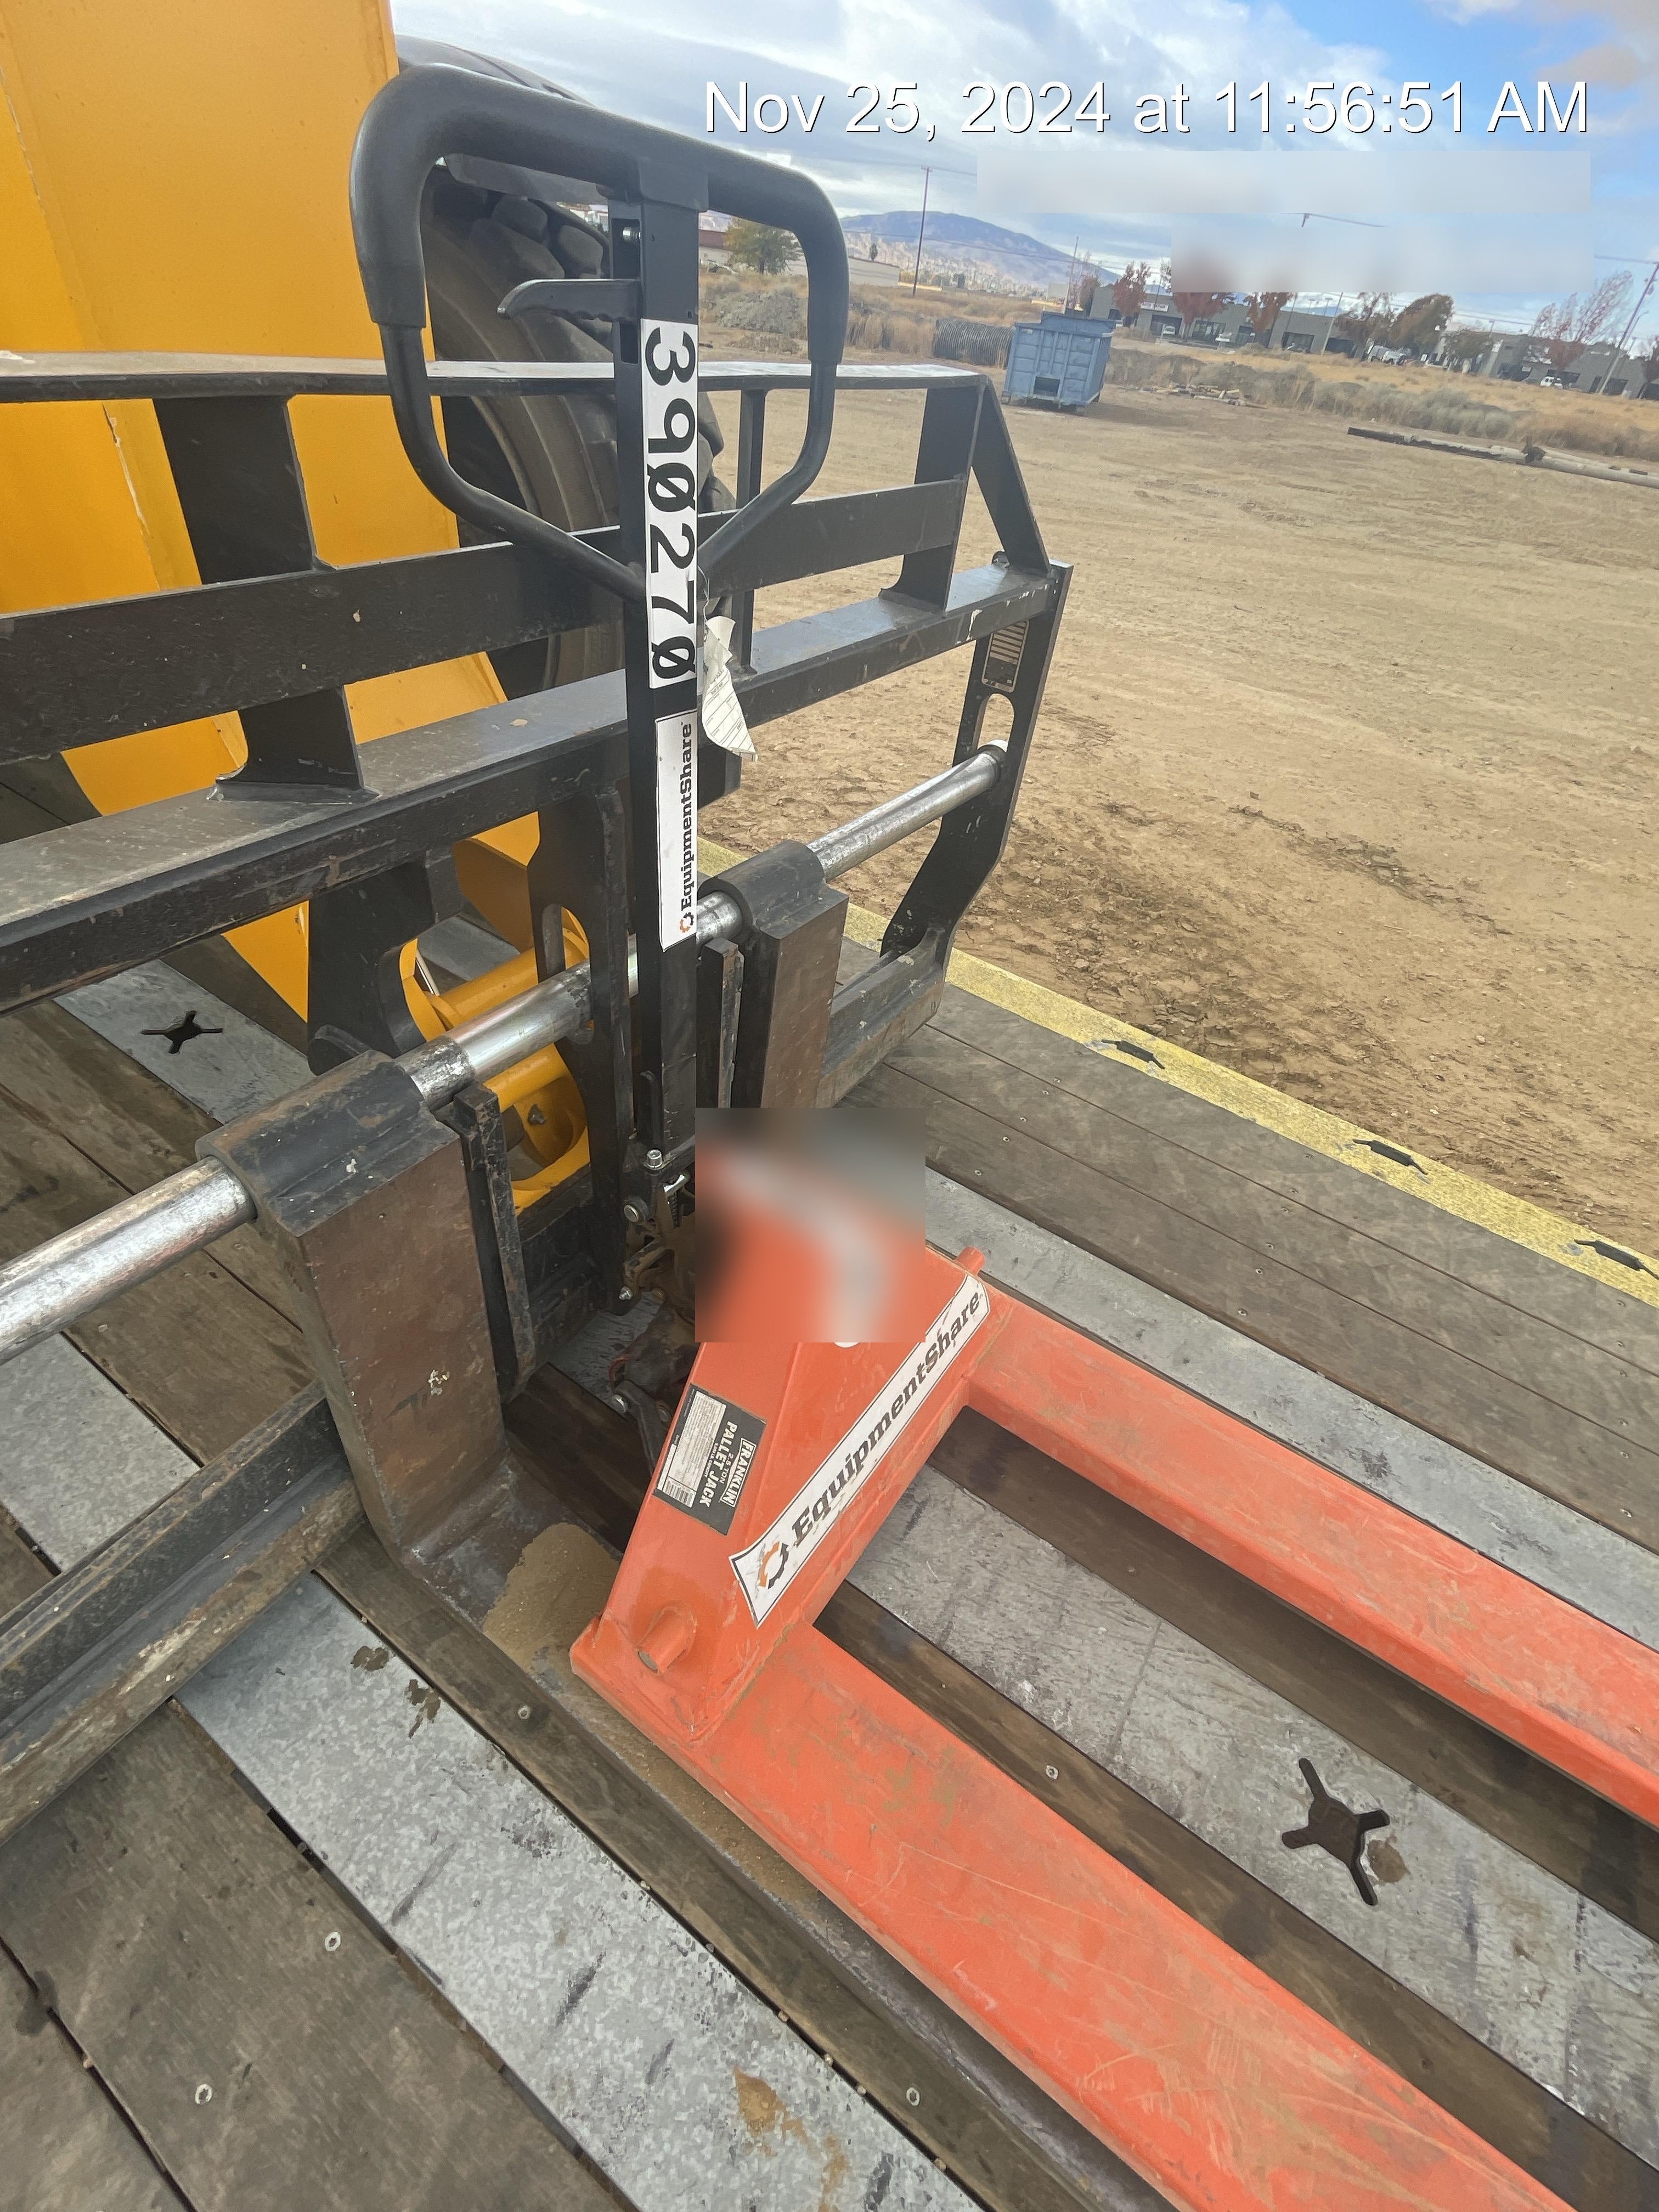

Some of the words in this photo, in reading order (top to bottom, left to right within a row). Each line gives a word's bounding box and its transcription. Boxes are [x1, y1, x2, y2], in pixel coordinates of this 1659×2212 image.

[645, 327, 696, 680] 390270
[681, 723, 695, 912] EquipmentShare
[713, 1421, 738, 1471] PALLET
[791, 1291, 980, 1548] EquipmentShare
[719, 1468, 729, 1485] TON
[721, 1441, 755, 1505] FRANKLIN
[725, 1452, 734, 1466] 2.5
[699, 1470, 719, 1508] JACK
